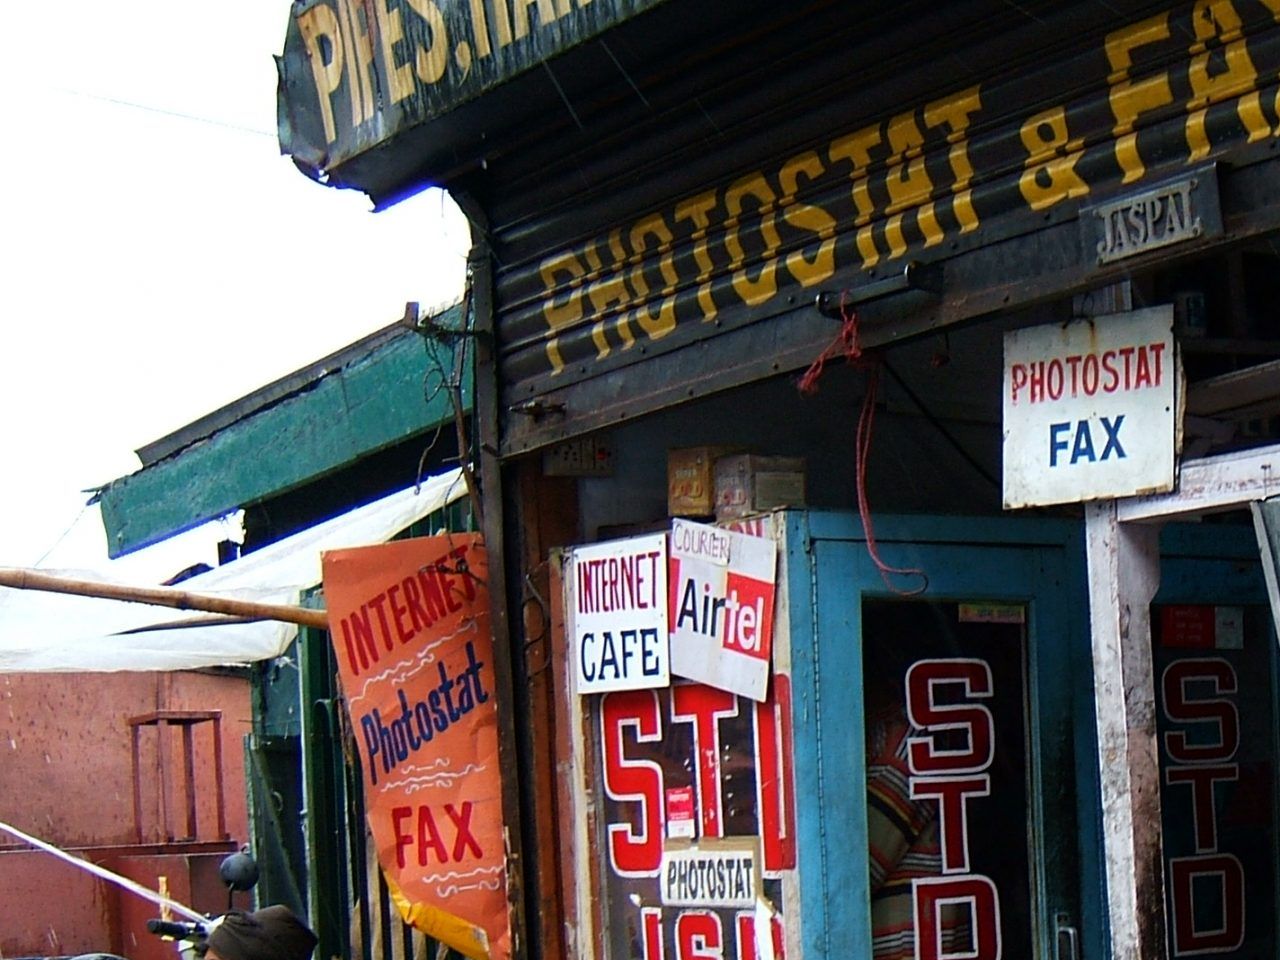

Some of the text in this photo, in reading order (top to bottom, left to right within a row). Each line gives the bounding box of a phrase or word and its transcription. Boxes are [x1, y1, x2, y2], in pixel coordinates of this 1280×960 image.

[538, 84, 983, 376] PHOTOSTAT
[1019, 105, 1090, 210] &
[1094, 178, 1201, 264] JASPAL
[1011, 343, 1165, 406] PHOTOSTAT
[1050, 415, 1127, 467] FAX
[673, 523, 729, 558] COURIER
[340, 545, 477, 676] INTERNET
[577, 551, 661, 614] INTERNET
[677, 578, 764, 652] Airtel
[580, 628, 660, 682] CAFE
[360, 641, 488, 786] Photostat
[391, 801, 484, 869] FAX
[1161, 656, 1245, 957] STD
[667, 858, 753, 900] PHOTOSTAT
